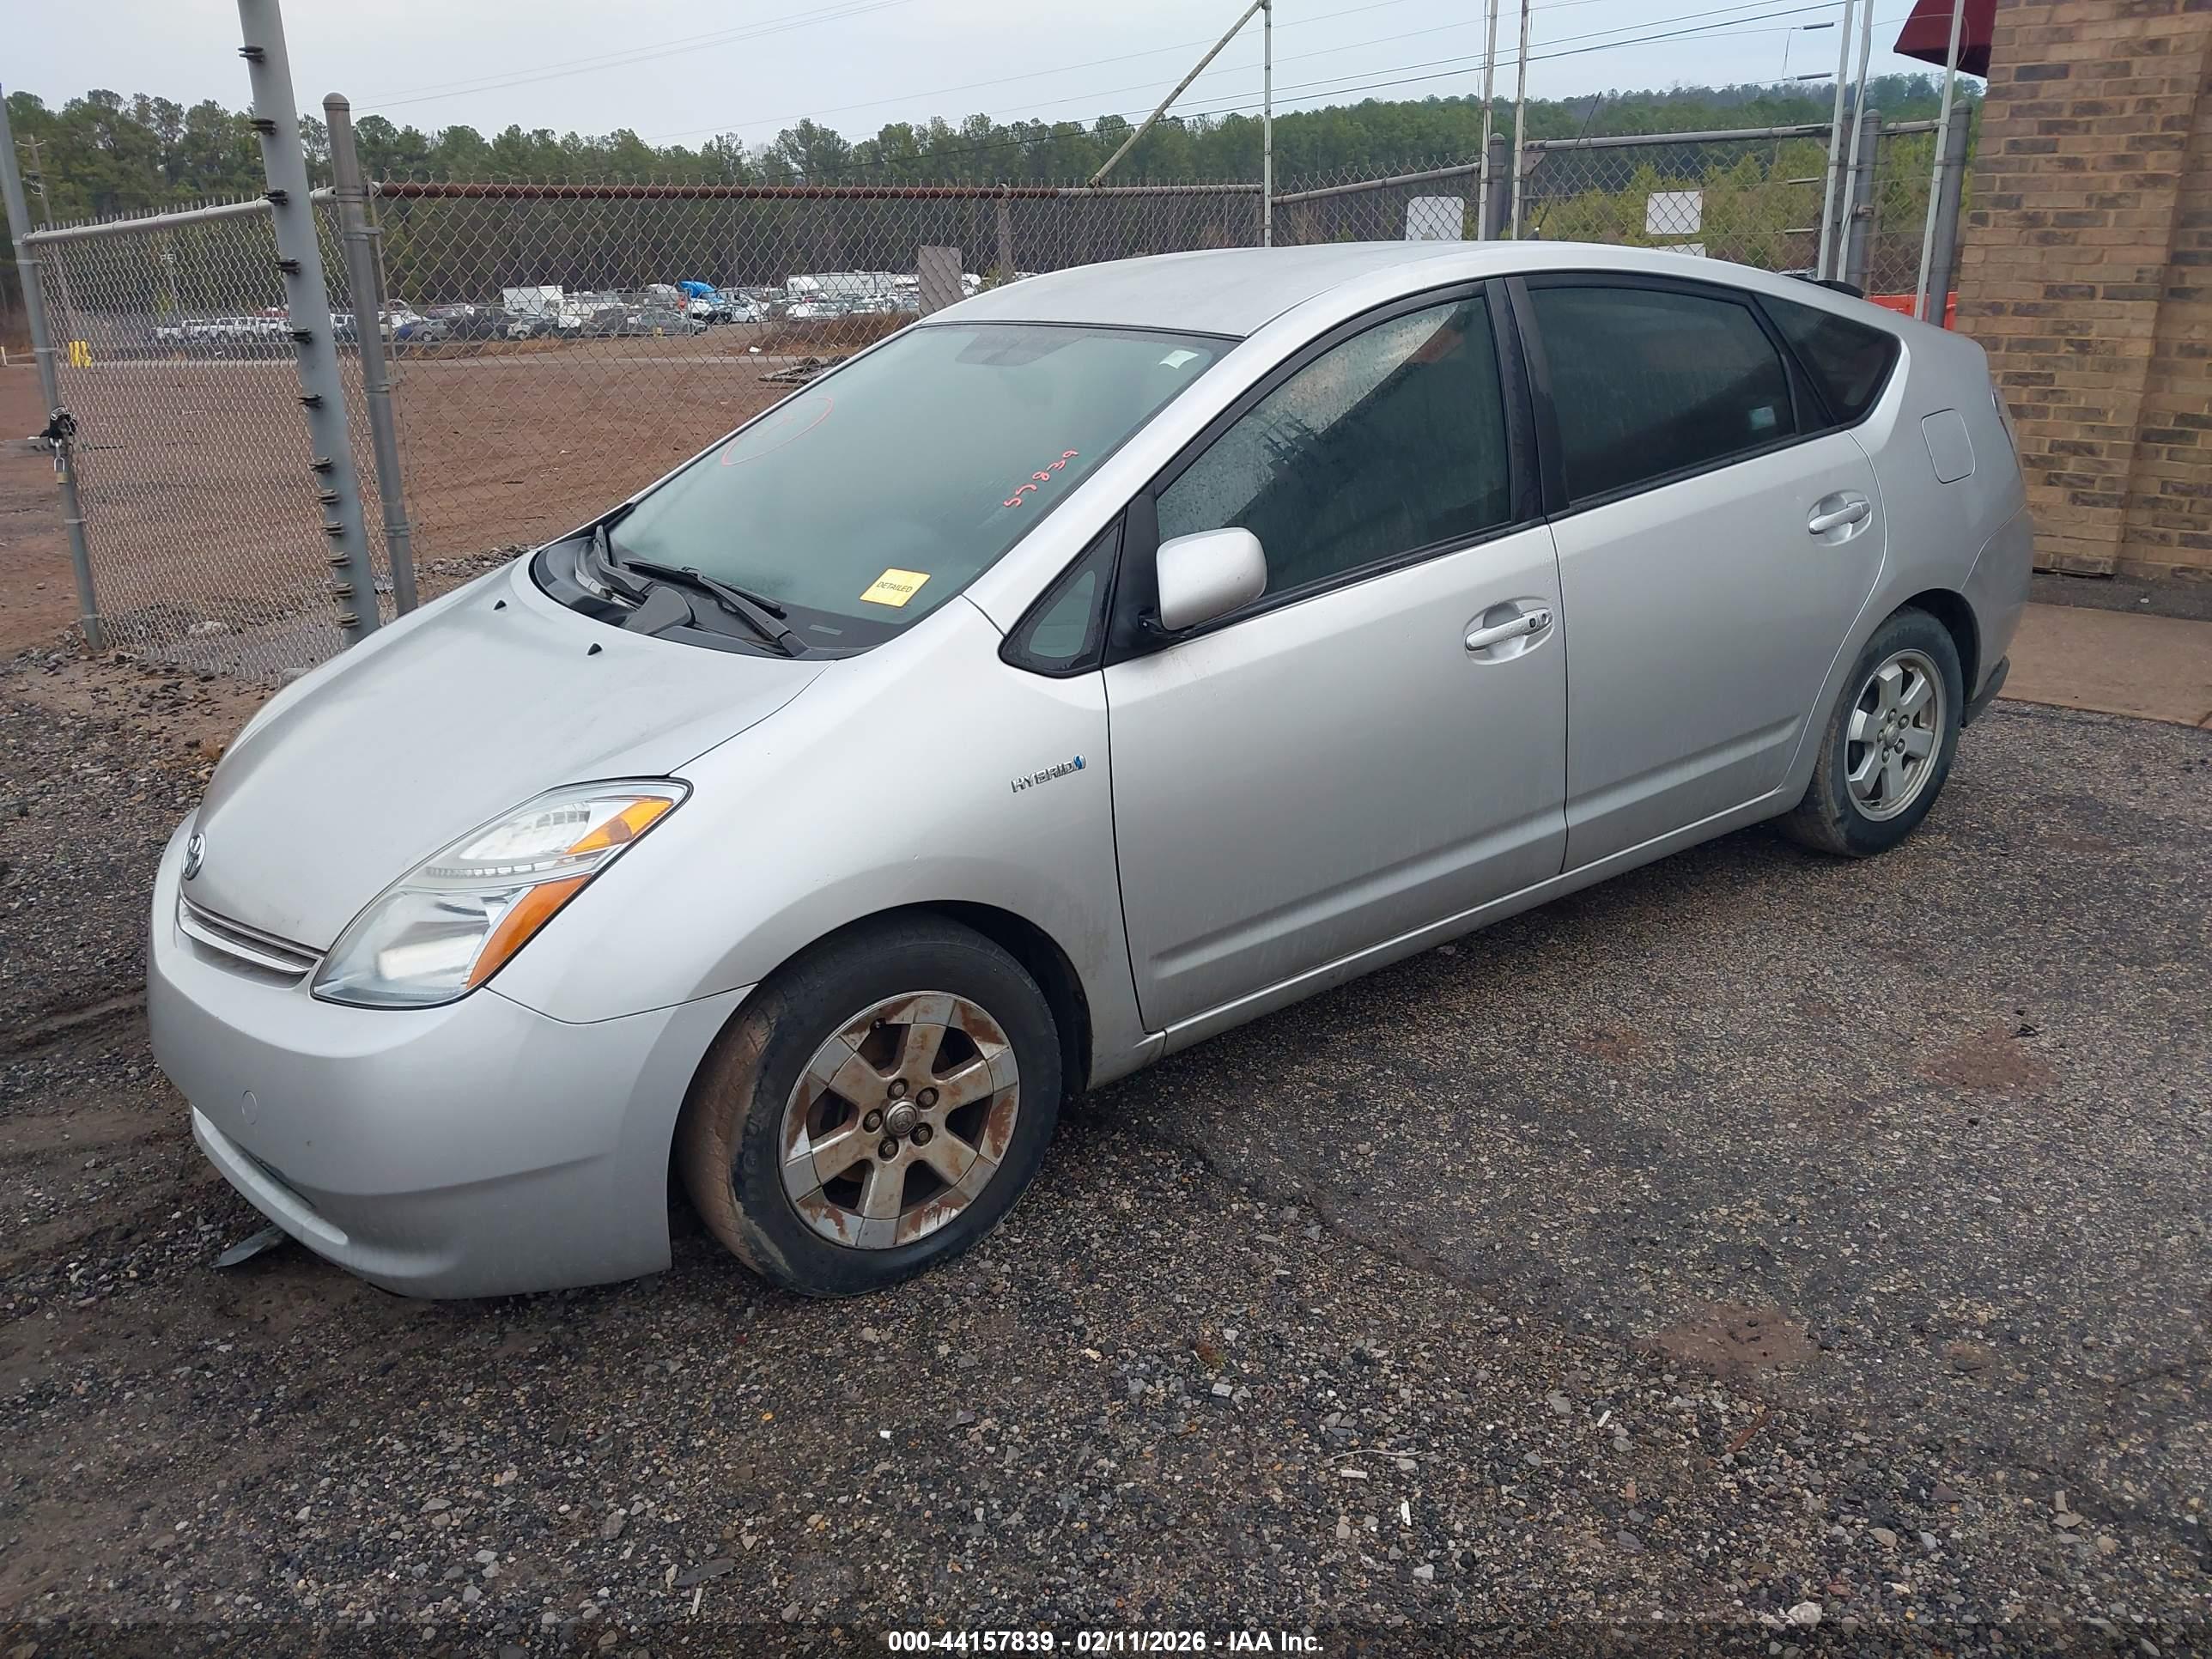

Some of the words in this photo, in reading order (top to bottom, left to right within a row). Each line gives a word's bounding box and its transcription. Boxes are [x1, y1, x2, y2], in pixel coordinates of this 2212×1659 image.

[1003, 449, 1079, 507] 57839
[876, 581, 914, 593] DETAILED
[1011, 760, 1076, 793] HYBRID
